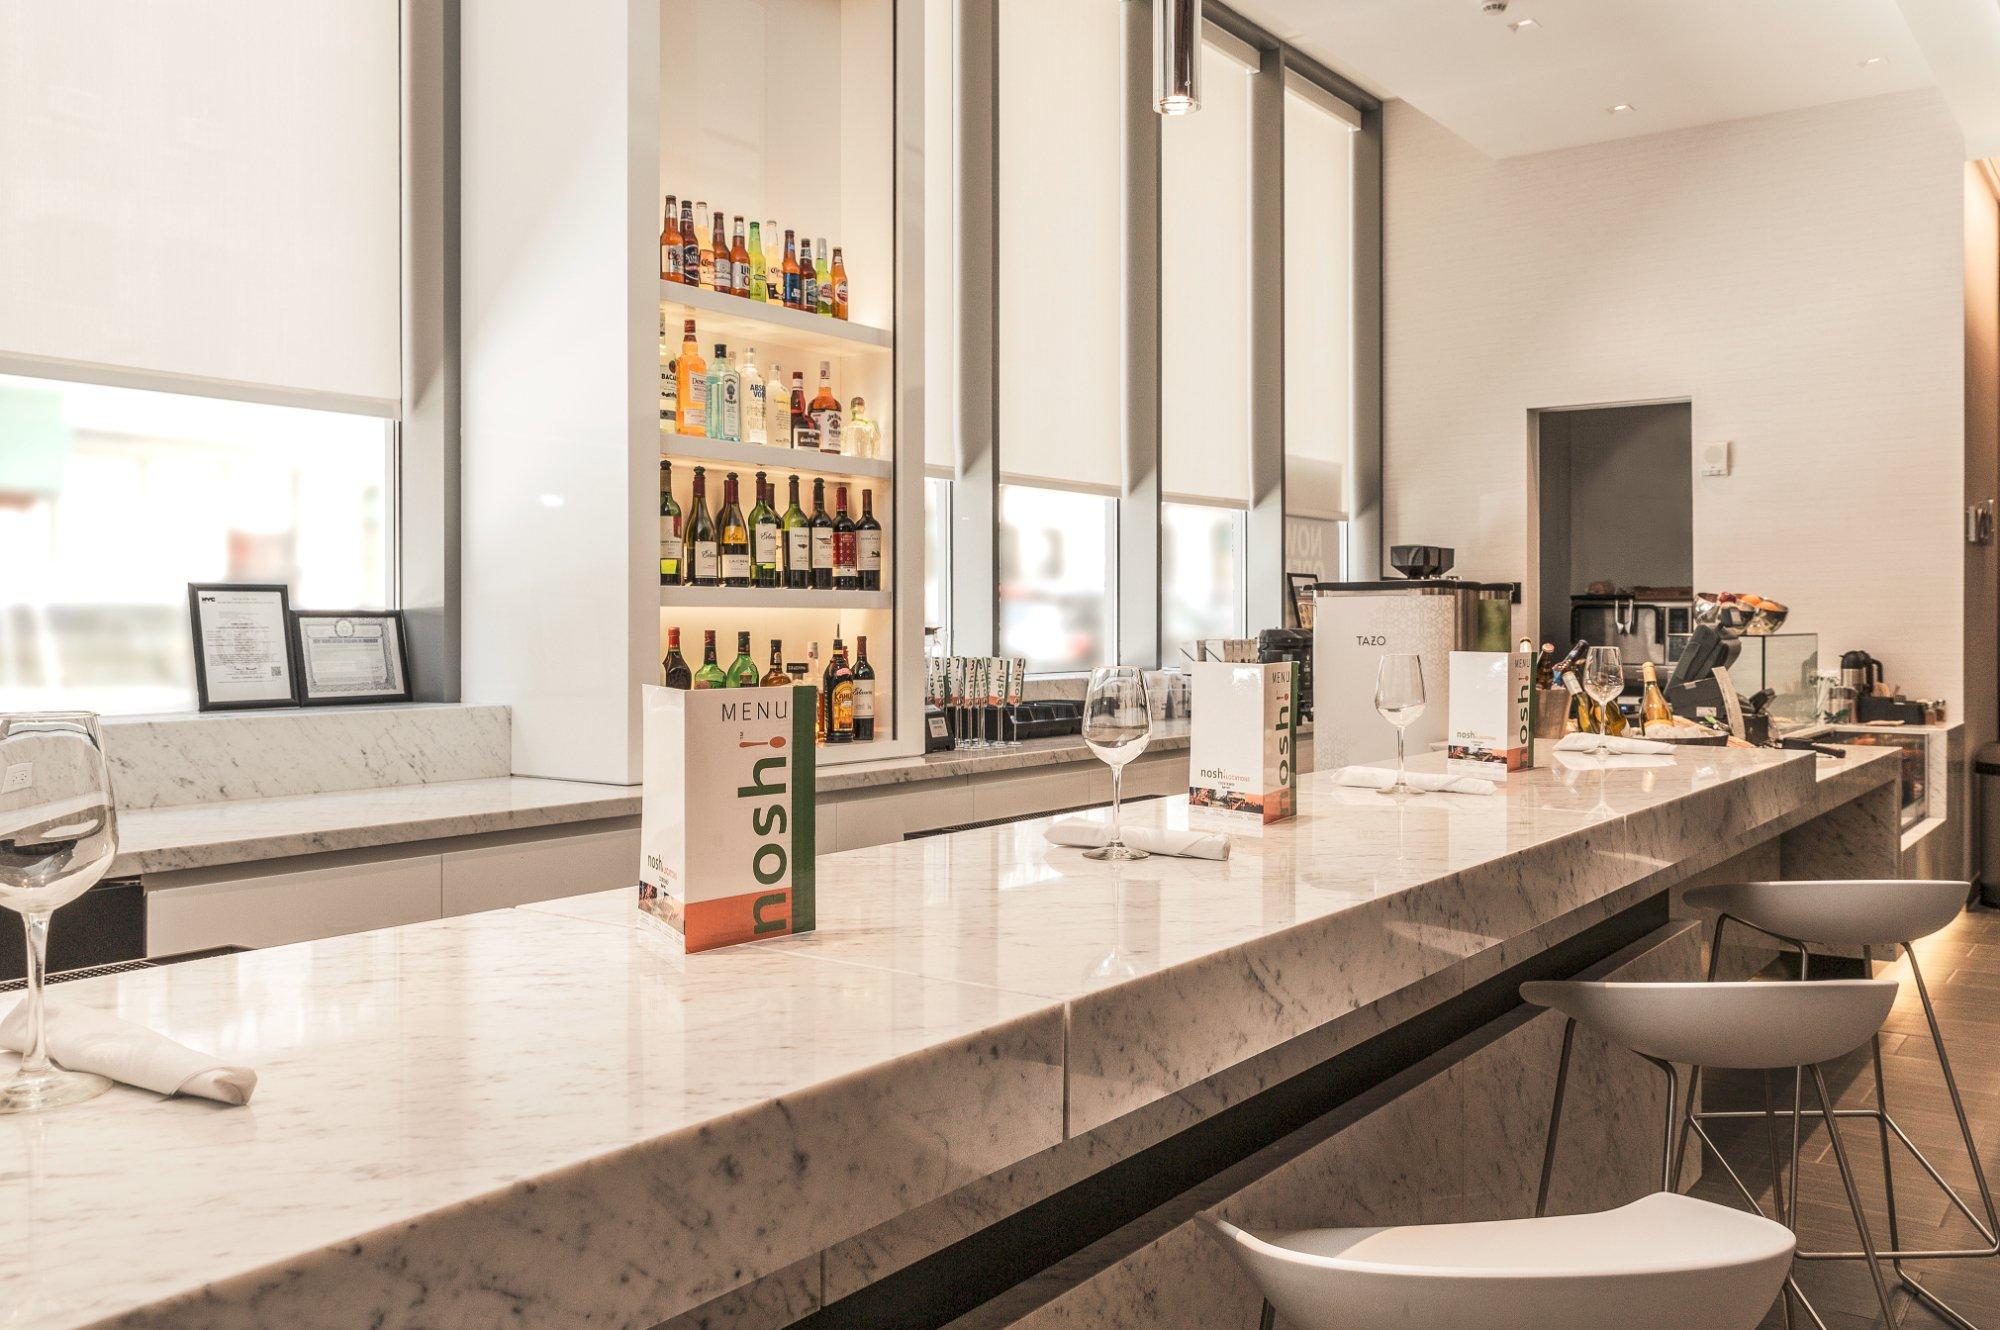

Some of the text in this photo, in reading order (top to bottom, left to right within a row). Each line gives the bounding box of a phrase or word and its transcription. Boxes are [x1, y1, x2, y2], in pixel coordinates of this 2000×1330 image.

[1356, 635, 1386, 646] TAZO
[1016, 658, 1022, 669] 4
[1514, 659, 1530, 668] MENU
[1271, 671, 1290, 684] MENU
[721, 700, 788, 722] MENU
